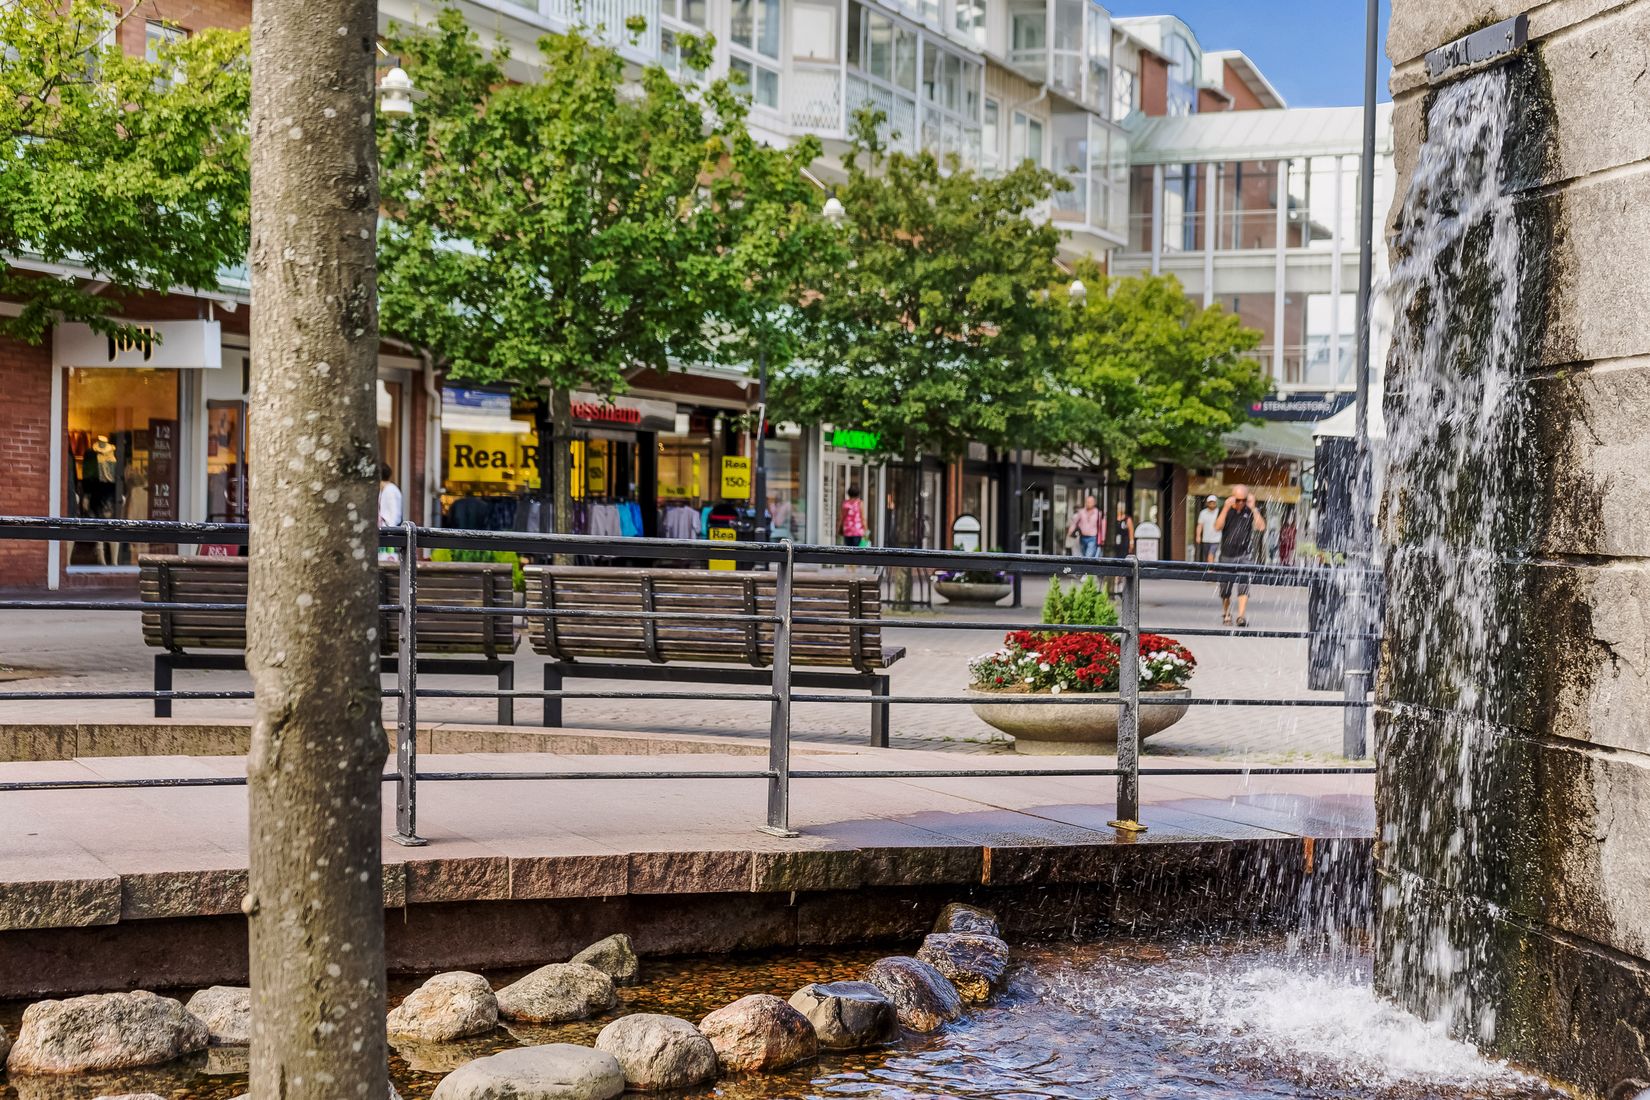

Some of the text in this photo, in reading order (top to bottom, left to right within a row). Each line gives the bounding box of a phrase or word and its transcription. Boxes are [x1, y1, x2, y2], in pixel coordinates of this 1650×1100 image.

[725, 460, 747, 469] Rea
[154, 483, 170, 497] 1/2
[712, 529, 735, 539] Rea
